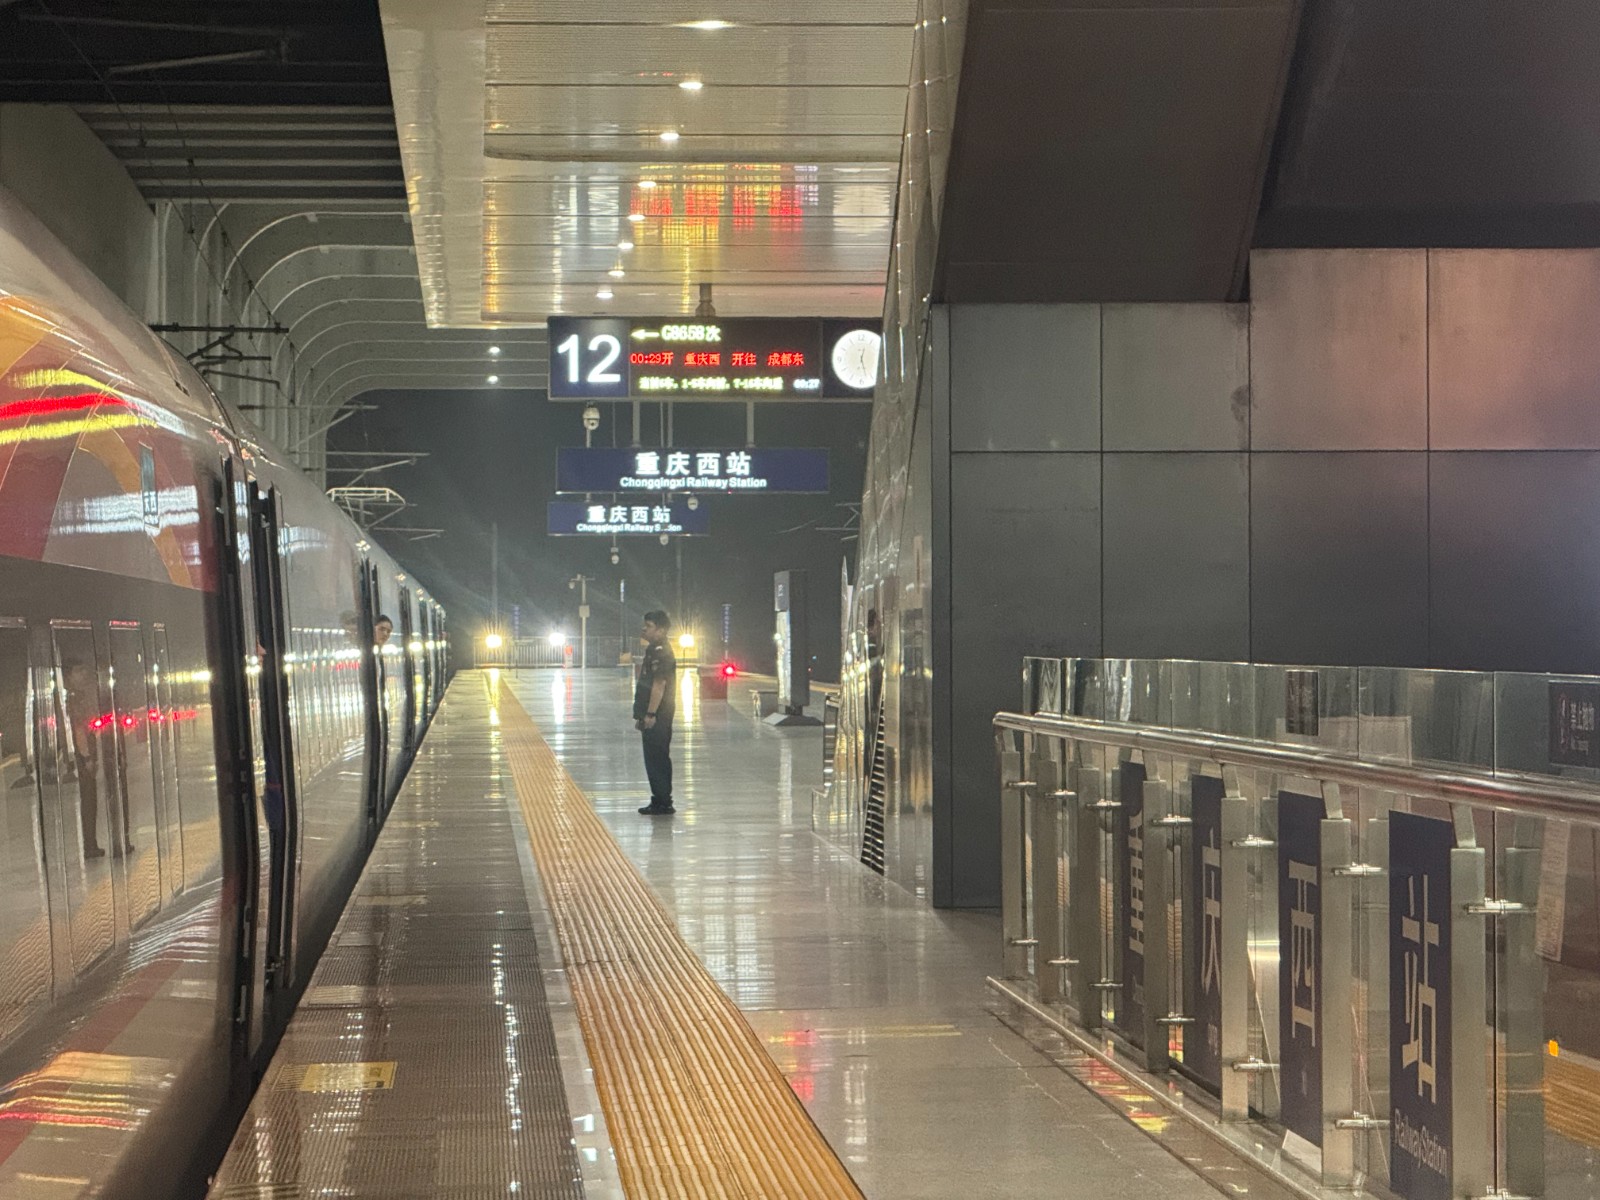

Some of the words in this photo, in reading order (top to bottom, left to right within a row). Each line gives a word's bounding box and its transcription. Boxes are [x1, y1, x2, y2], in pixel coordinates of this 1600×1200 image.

[557, 333, 621, 383] 12
[630, 352, 674, 366] 00:29开
[684, 352, 721, 366] 重庆西
[731, 352, 757, 366] 开往
[767, 352, 804, 366] 成都东
[635, 452, 752, 476] 重庆西站
[620, 476, 685, 489] Chongqingxi
[687, 476, 728, 489] Railway
[729, 477, 767, 488] Station
[587, 505, 671, 523] 重庆西站
[625, 523, 654, 533] Railway
[655, 524, 682, 532] Sion
[1288, 859, 1318, 1048] 西
[1401, 873, 1440, 1104] 站
[1394, 1107, 1421, 1169] Railway
[1421, 1125, 1448, 1178] Station
